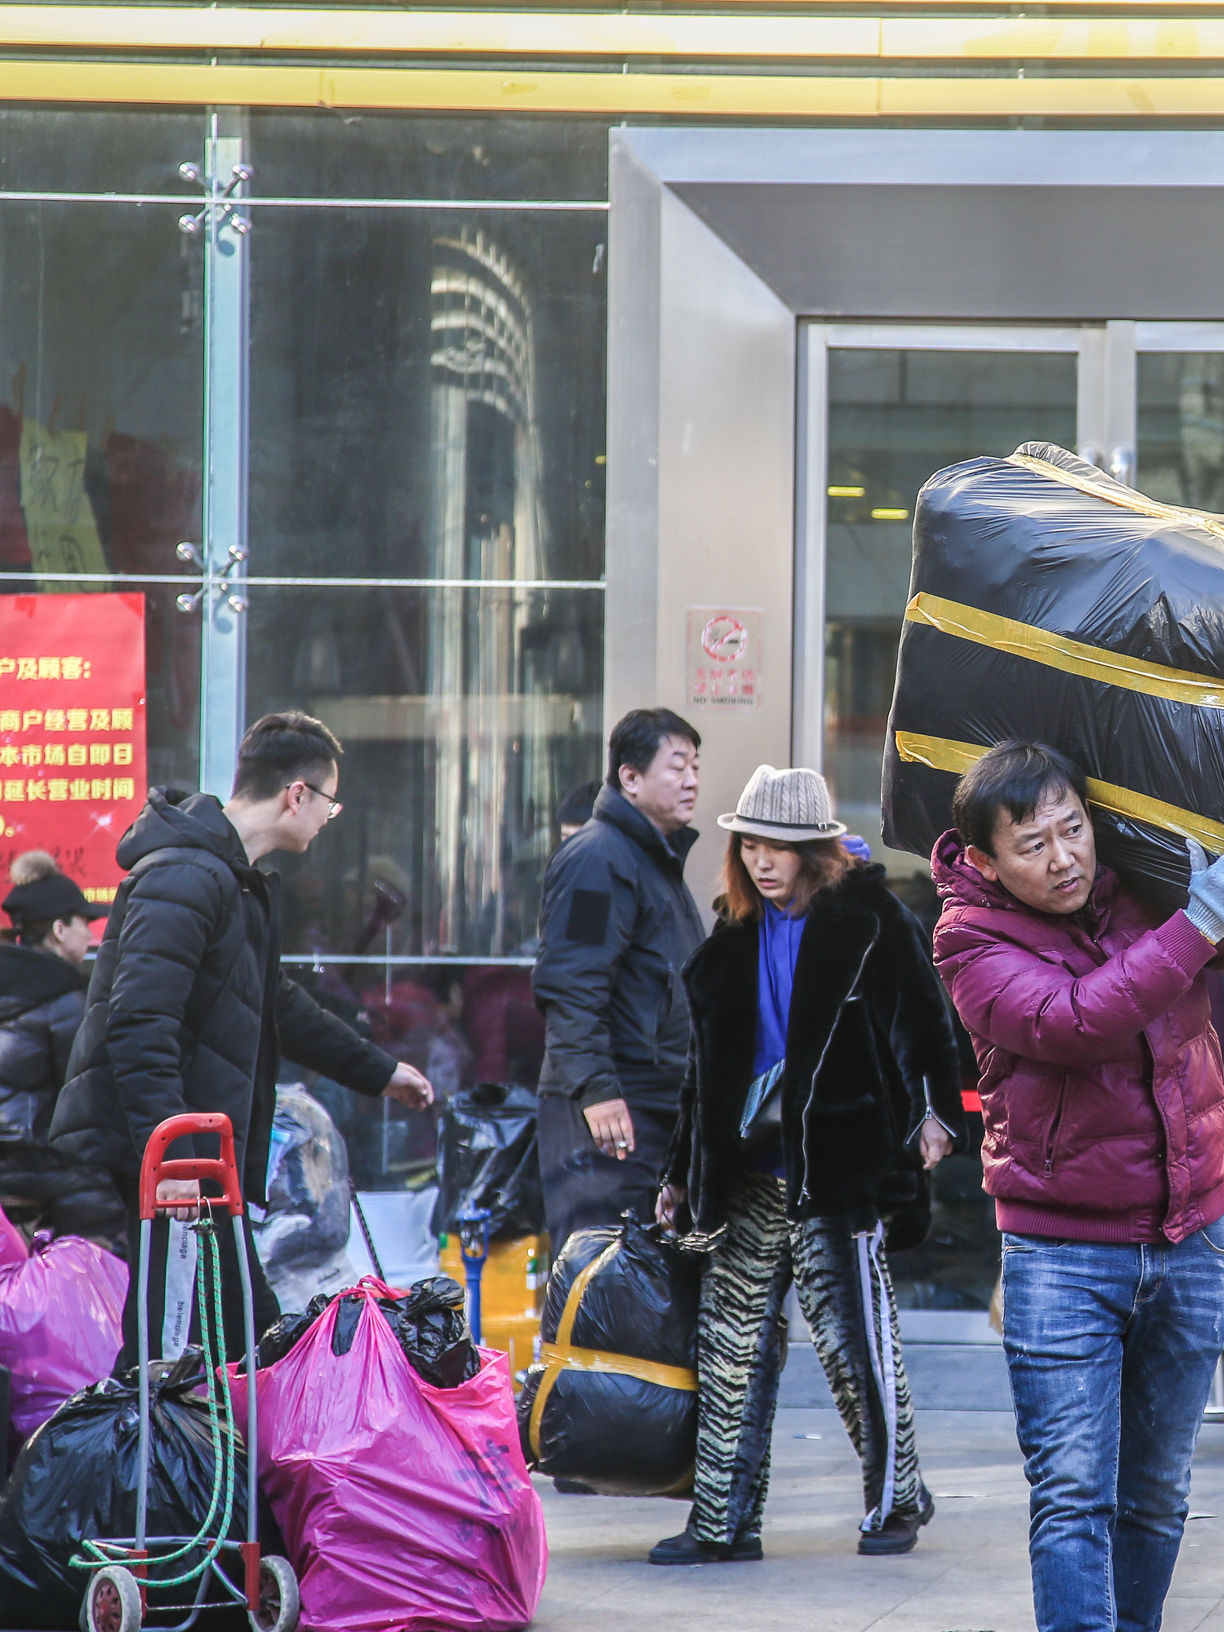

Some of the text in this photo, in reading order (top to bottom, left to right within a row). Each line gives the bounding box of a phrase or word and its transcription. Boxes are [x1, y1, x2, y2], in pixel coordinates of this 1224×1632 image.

[0, 777, 135, 802] 延长营业时间
